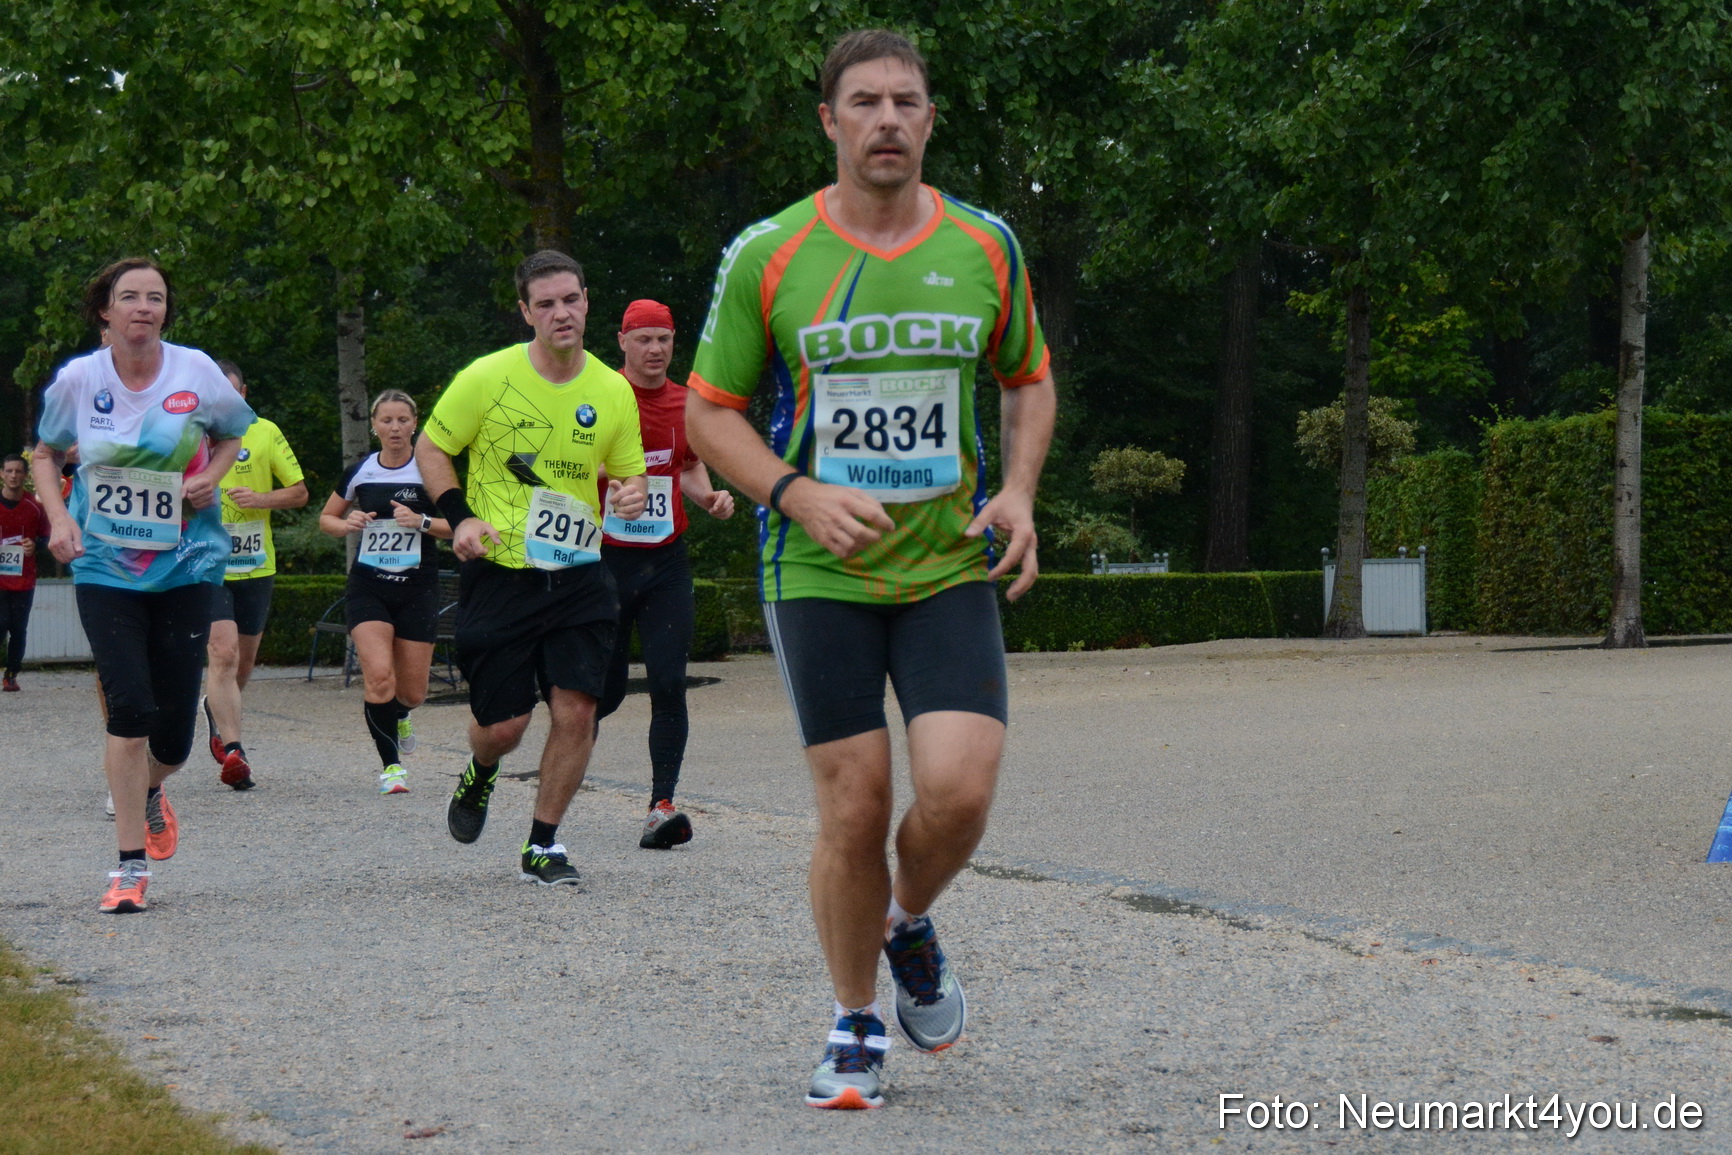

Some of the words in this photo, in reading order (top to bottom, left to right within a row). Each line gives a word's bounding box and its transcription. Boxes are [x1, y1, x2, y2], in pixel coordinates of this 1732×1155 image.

[798, 312, 982, 369] BOCK
[880, 375, 946, 393] BOCK
[832, 402, 947, 452] 2834
[129, 470, 173, 485] BOCK
[566, 471, 590, 480] YEARS
[847, 465, 933, 488] Wolfgang
[95, 484, 173, 519] 2318
[110, 522, 153, 538] Andrea
[535, 509, 597, 548] 2917
[624, 522, 655, 533] Robert
[367, 532, 416, 552] 2227
[379, 556, 400, 565] Kathi
